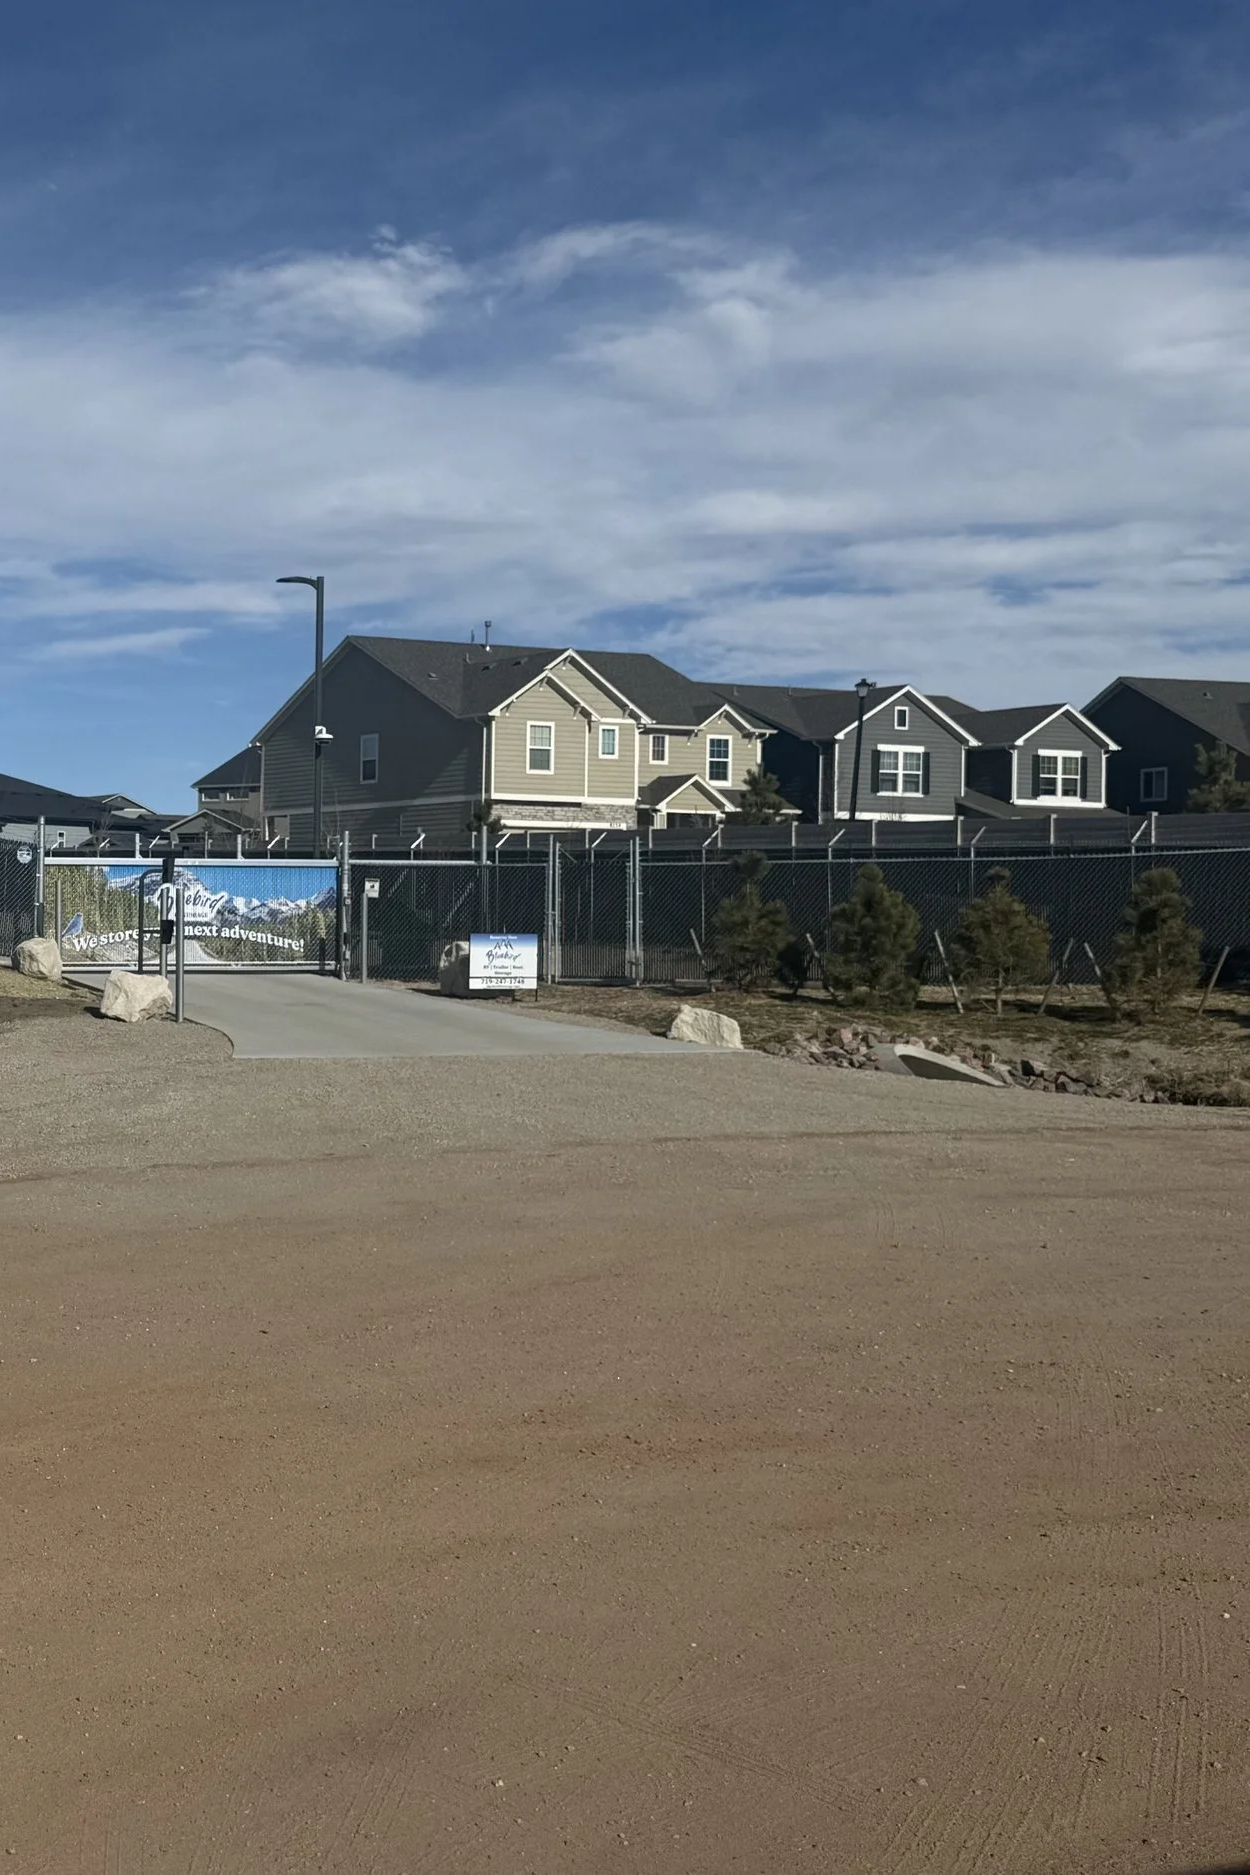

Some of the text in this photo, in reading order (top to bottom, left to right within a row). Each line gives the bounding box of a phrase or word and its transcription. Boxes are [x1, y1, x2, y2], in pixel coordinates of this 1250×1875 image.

[72, 935, 98, 952] We
[100, 928, 139, 946] store
[183, 924, 219, 937] next
[220, 924, 305, 953] adventure!
